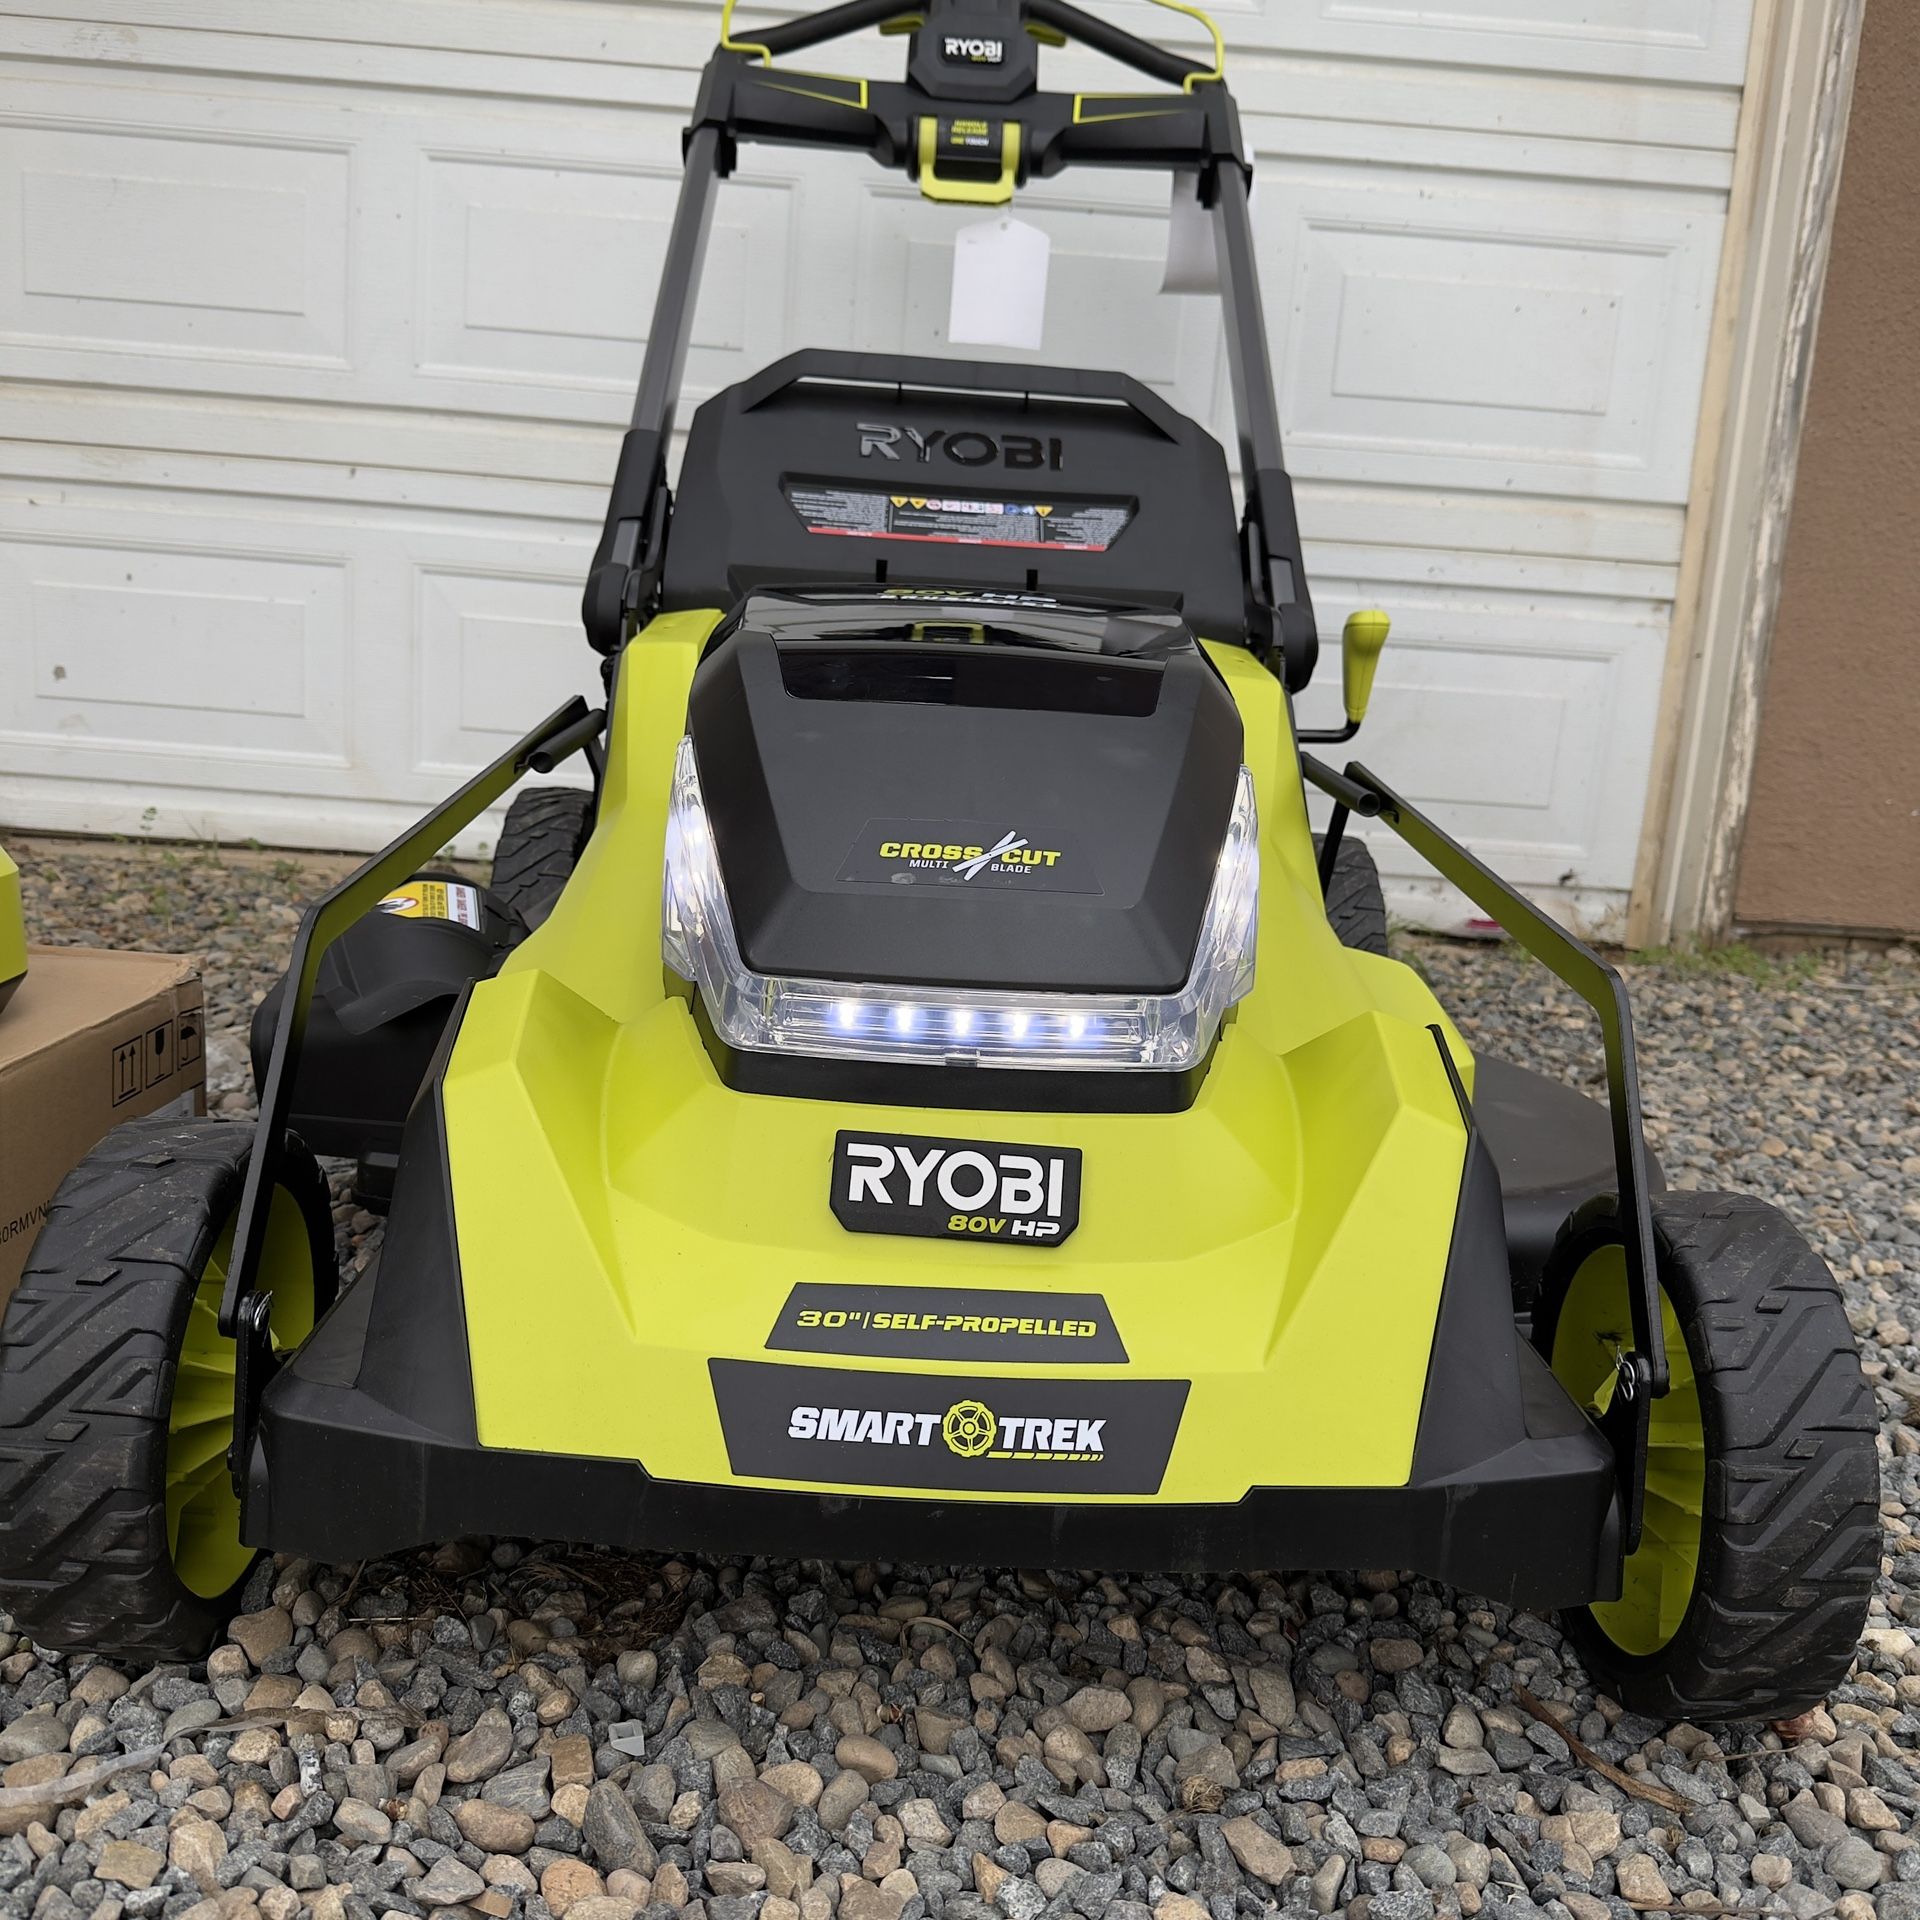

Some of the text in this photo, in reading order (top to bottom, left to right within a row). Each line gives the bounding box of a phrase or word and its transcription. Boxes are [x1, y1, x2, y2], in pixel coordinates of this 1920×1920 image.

[945, 38, 1003, 58] RYOBI
[856, 422, 1063, 471] RYOBI
[879, 842, 1061, 866] CROSS CUT
[909, 859, 1032, 874] MULTI BLADE
[847, 1142, 1064, 1217] RYOBI
[947, 1215, 1060, 1237] 80V HP
[797, 1310, 1097, 1337] 30" SELF-PROPELLED
[787, 1406, 1106, 1452] SMART TREK
